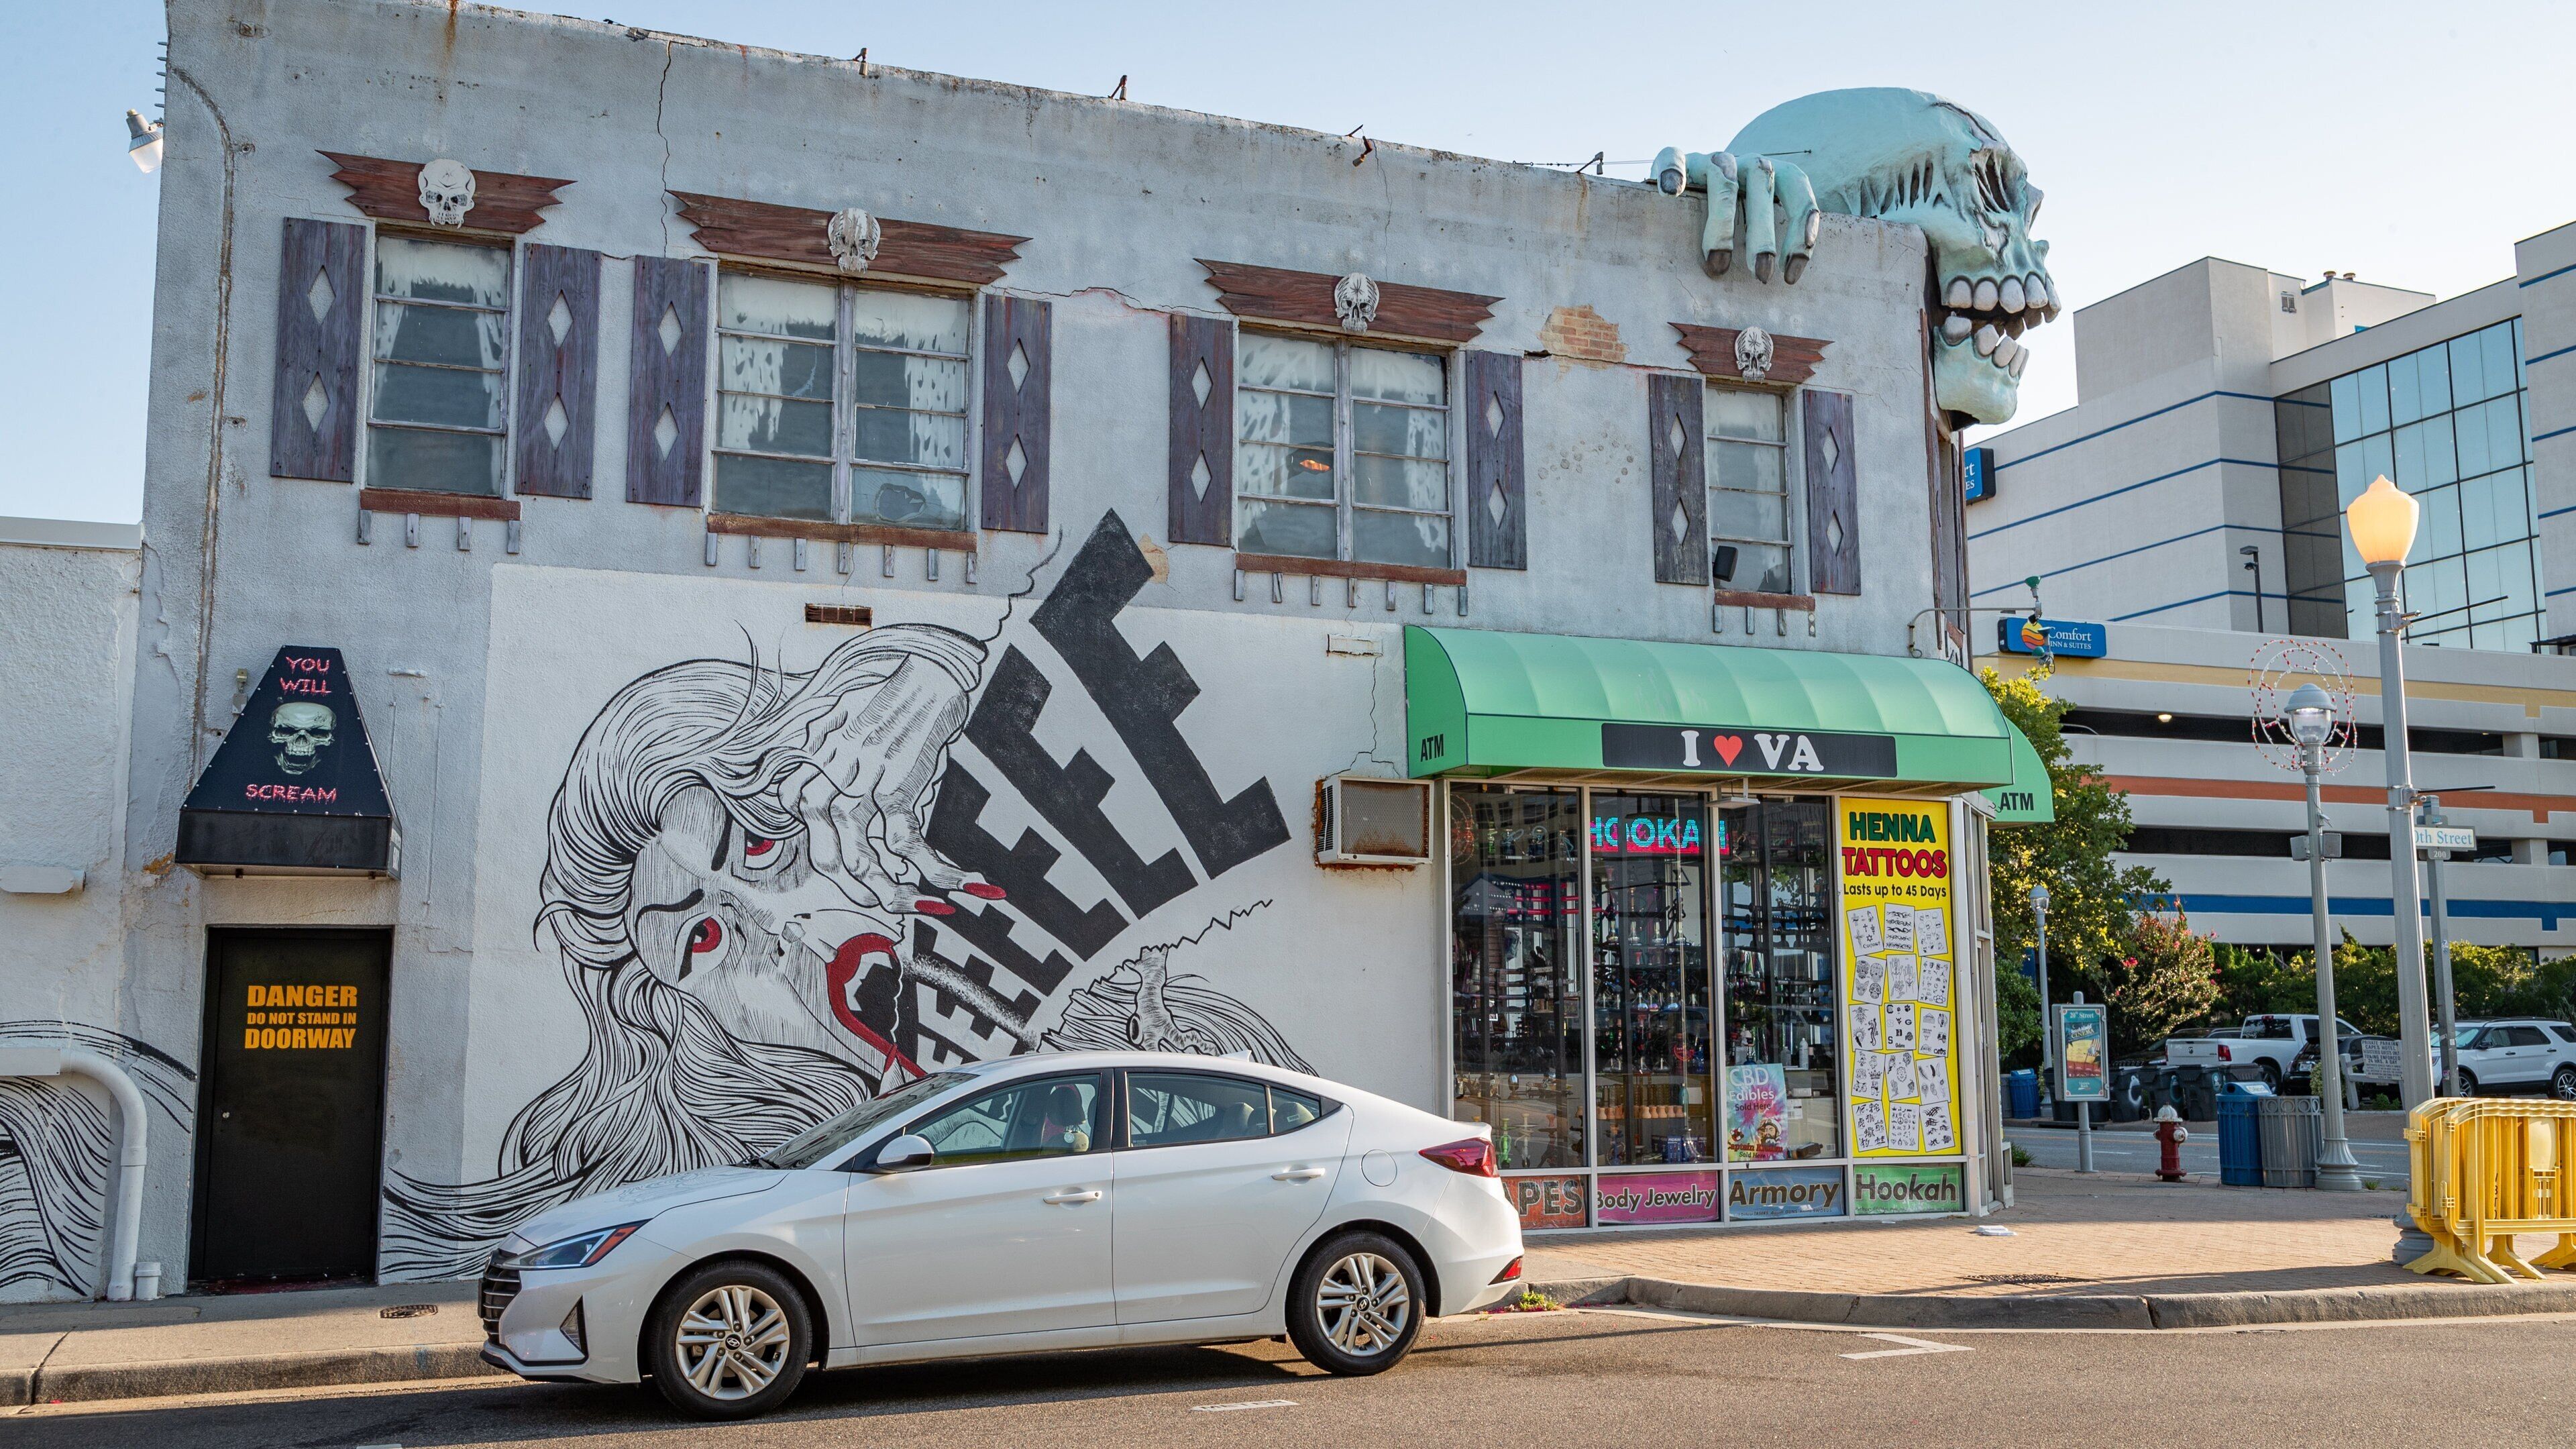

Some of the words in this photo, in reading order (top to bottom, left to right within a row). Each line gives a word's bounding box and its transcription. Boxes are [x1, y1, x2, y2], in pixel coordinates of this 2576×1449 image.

[2048, 627, 2092, 641] Comfort
[2069, 642, 2092, 650] SUITES
[285, 656, 330, 674] YOU
[279, 678, 332, 696] WILL
[1420, 733, 1444, 762] ATM
[1681, 730, 1701, 767] I
[1754, 733, 1824, 771] VA
[246, 784, 337, 804] SCREAM
[2000, 792, 2034, 810] ATM
[1849, 812, 1936, 843] HENNA
[2437, 830, 2473, 845] Street
[1841, 847, 1947, 878] TATTOOS
[1843, 883, 1871, 896] Lasts
[1875, 886, 1888, 898] up
[1892, 884, 1902, 896] to
[1906, 885, 1917, 896] 45
[1921, 885, 1947, 900] Days
[248, 985, 358, 1007] DANGER
[247, 1012, 266, 1024] DO
[269, 1012, 295, 1024] NOT
[297, 1012, 340, 1024] STAND
[343, 1012, 357, 1024] IN
[245, 1028, 356, 1049] DOORWAY
[2071, 1028, 2094, 1038] CINEMA
[1729, 1067, 1769, 1087] CBD
[1729, 1088, 1774, 1101] Edibles
[1644, 1184, 1716, 1208] Jewelry
[1729, 1179, 1841, 1208] Armory
[1855, 1173, 1957, 1201] Hookah
[1503, 1179, 1583, 1216] PES
